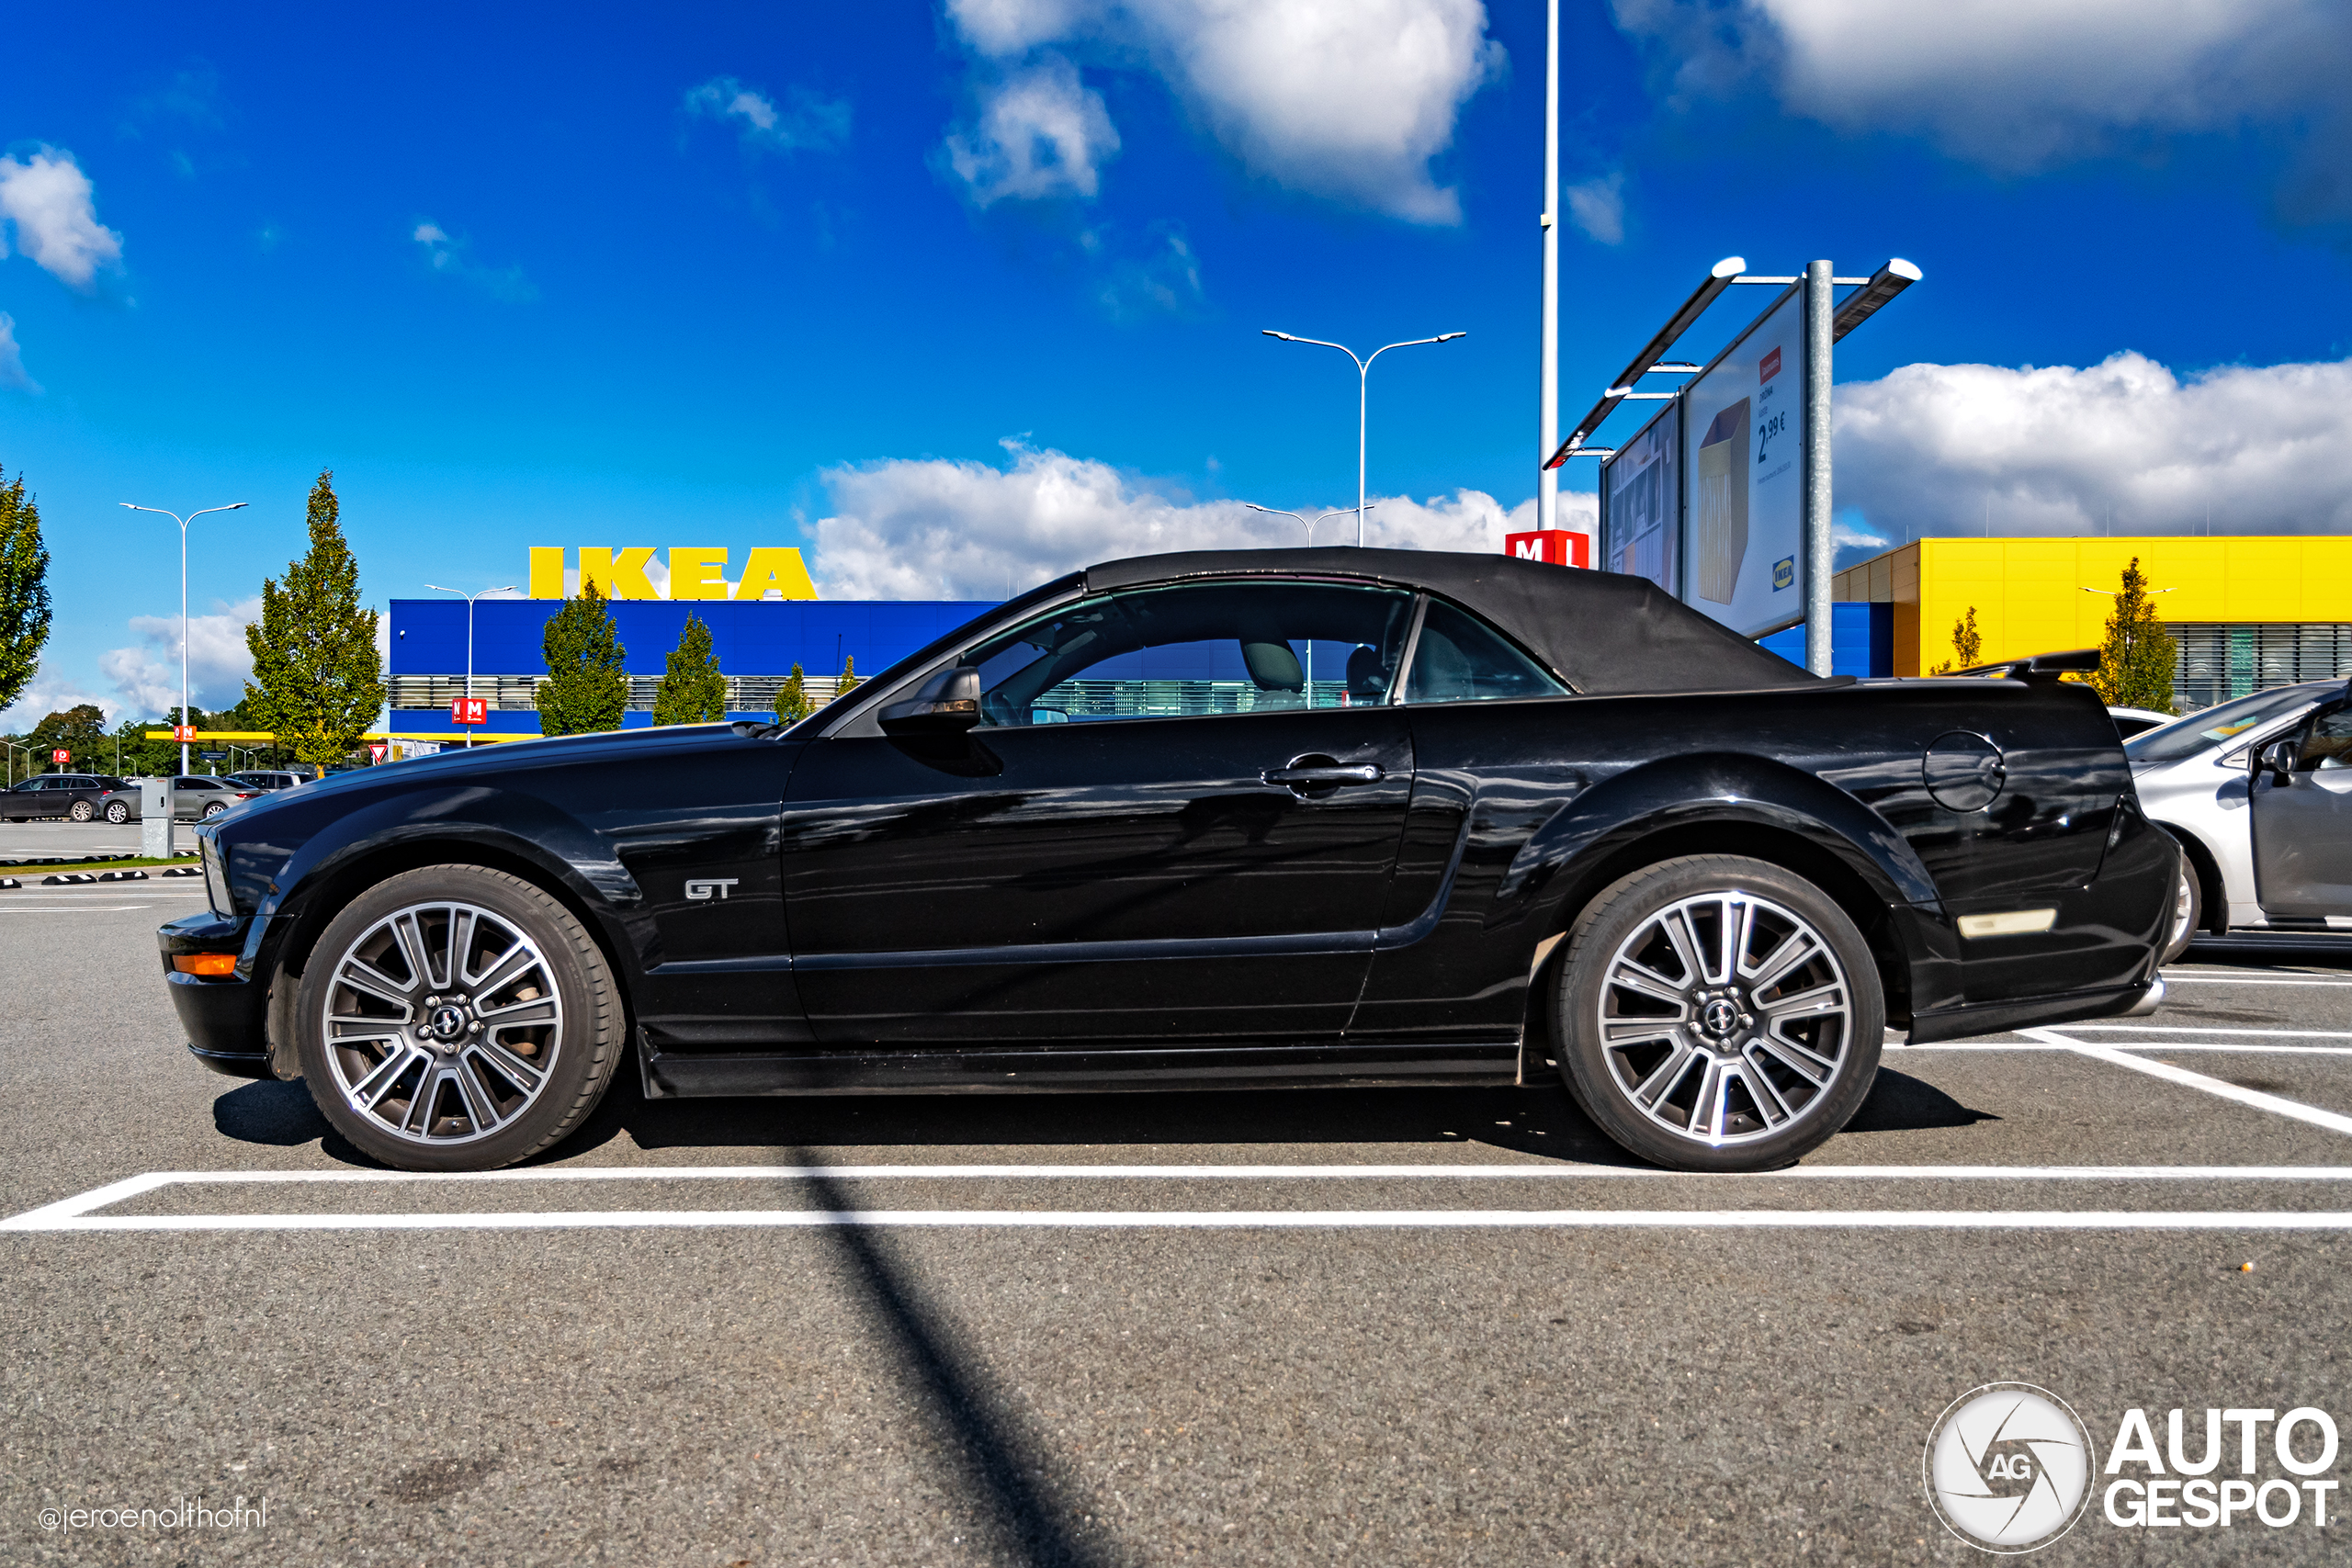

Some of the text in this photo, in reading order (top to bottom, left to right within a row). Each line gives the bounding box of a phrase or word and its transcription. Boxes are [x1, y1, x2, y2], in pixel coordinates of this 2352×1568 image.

[1758, 411, 1785, 465] 2,99 €
[1515, 537, 1543, 562] M
[1566, 538, 1579, 569] L
[528, 547, 820, 600] IKEA
[1774, 564, 1792, 583] IKEA
[454, 701, 460, 716] N
[467, 701, 482, 716] M
[183, 727, 193, 737] N
[59, 750, 67, 759] O
[684, 877, 740, 900] GT
